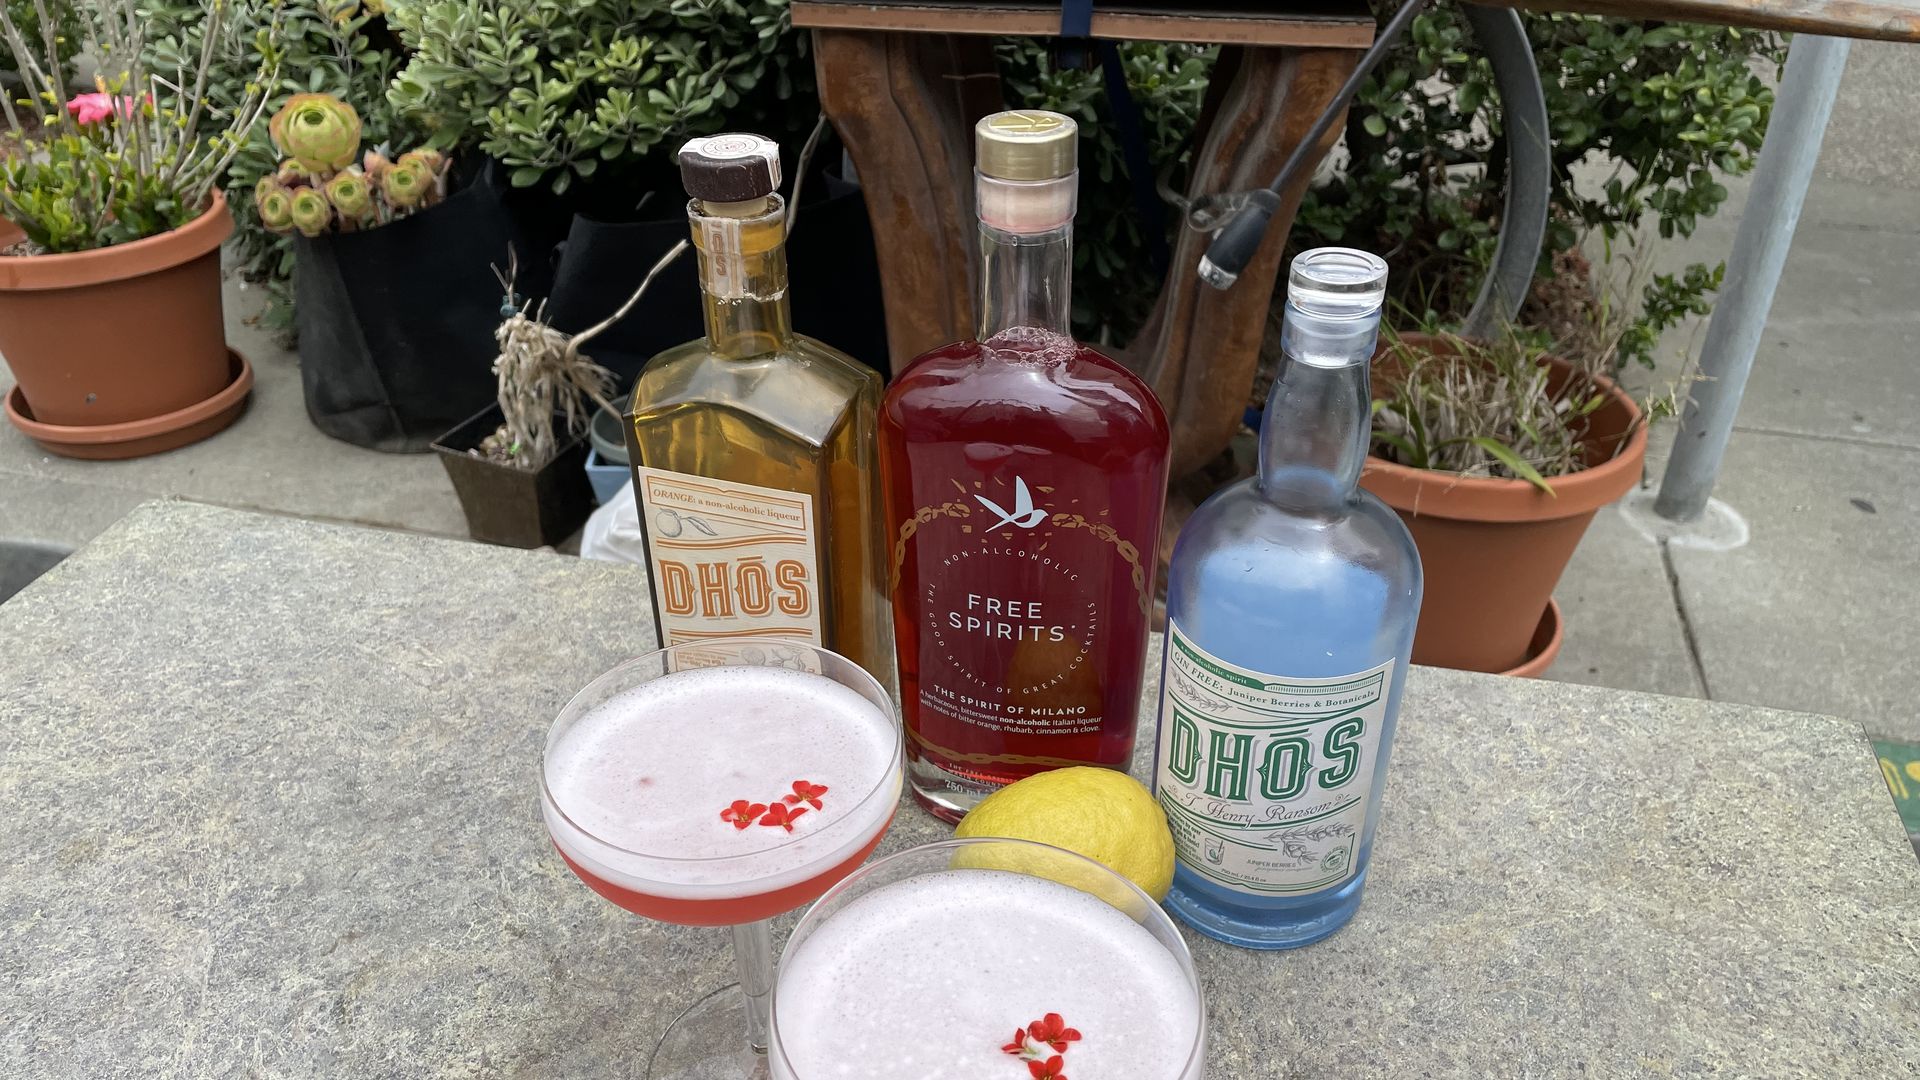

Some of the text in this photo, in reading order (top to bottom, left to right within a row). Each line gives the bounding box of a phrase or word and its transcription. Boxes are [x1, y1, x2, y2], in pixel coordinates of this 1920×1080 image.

[653, 488, 696, 503] ORANGE:
[705, 499, 766, 516] non-alcoholic
[767, 508, 801, 521] liqueur
[944, 547, 1078, 581] NON-ALCOHOLIC
[968, 593, 1043, 619] FREE
[927, 583, 1097, 695] THE GOOD SPIRIT OF GREAT COCKTAILS
[949, 611, 1065, 642] SPIRITS
[1174, 651, 1375, 708] GIN FREE: Juniper Berries & Botanicals
[1184, 647, 1225, 676] non-alcoholic
[1226, 673, 1247, 685] spirit
[924, 690, 960, 713] herbaceous,
[960, 706, 998, 722] bittersweet
[999, 717, 1051, 727] non-alcoholic
[1076, 716, 1102, 726] liqueur
[934, 684, 1086, 716] THE SPIRIT OF MILANO
[920, 699, 933, 708] with
[933, 703, 950, 716] notes
[950, 711, 957, 719] of
[958, 713, 976, 724] bitter
[976, 720, 1003, 731] orange,
[1003, 725, 1035, 735] rhubarb,
[1035, 727, 1072, 735] cinnamon
[1080, 725, 1101, 733] clove.
[944, 779, 963, 793] 750
[1200, 802, 1255, 828] Henry
[1258, 801, 1333, 821] Ransom
